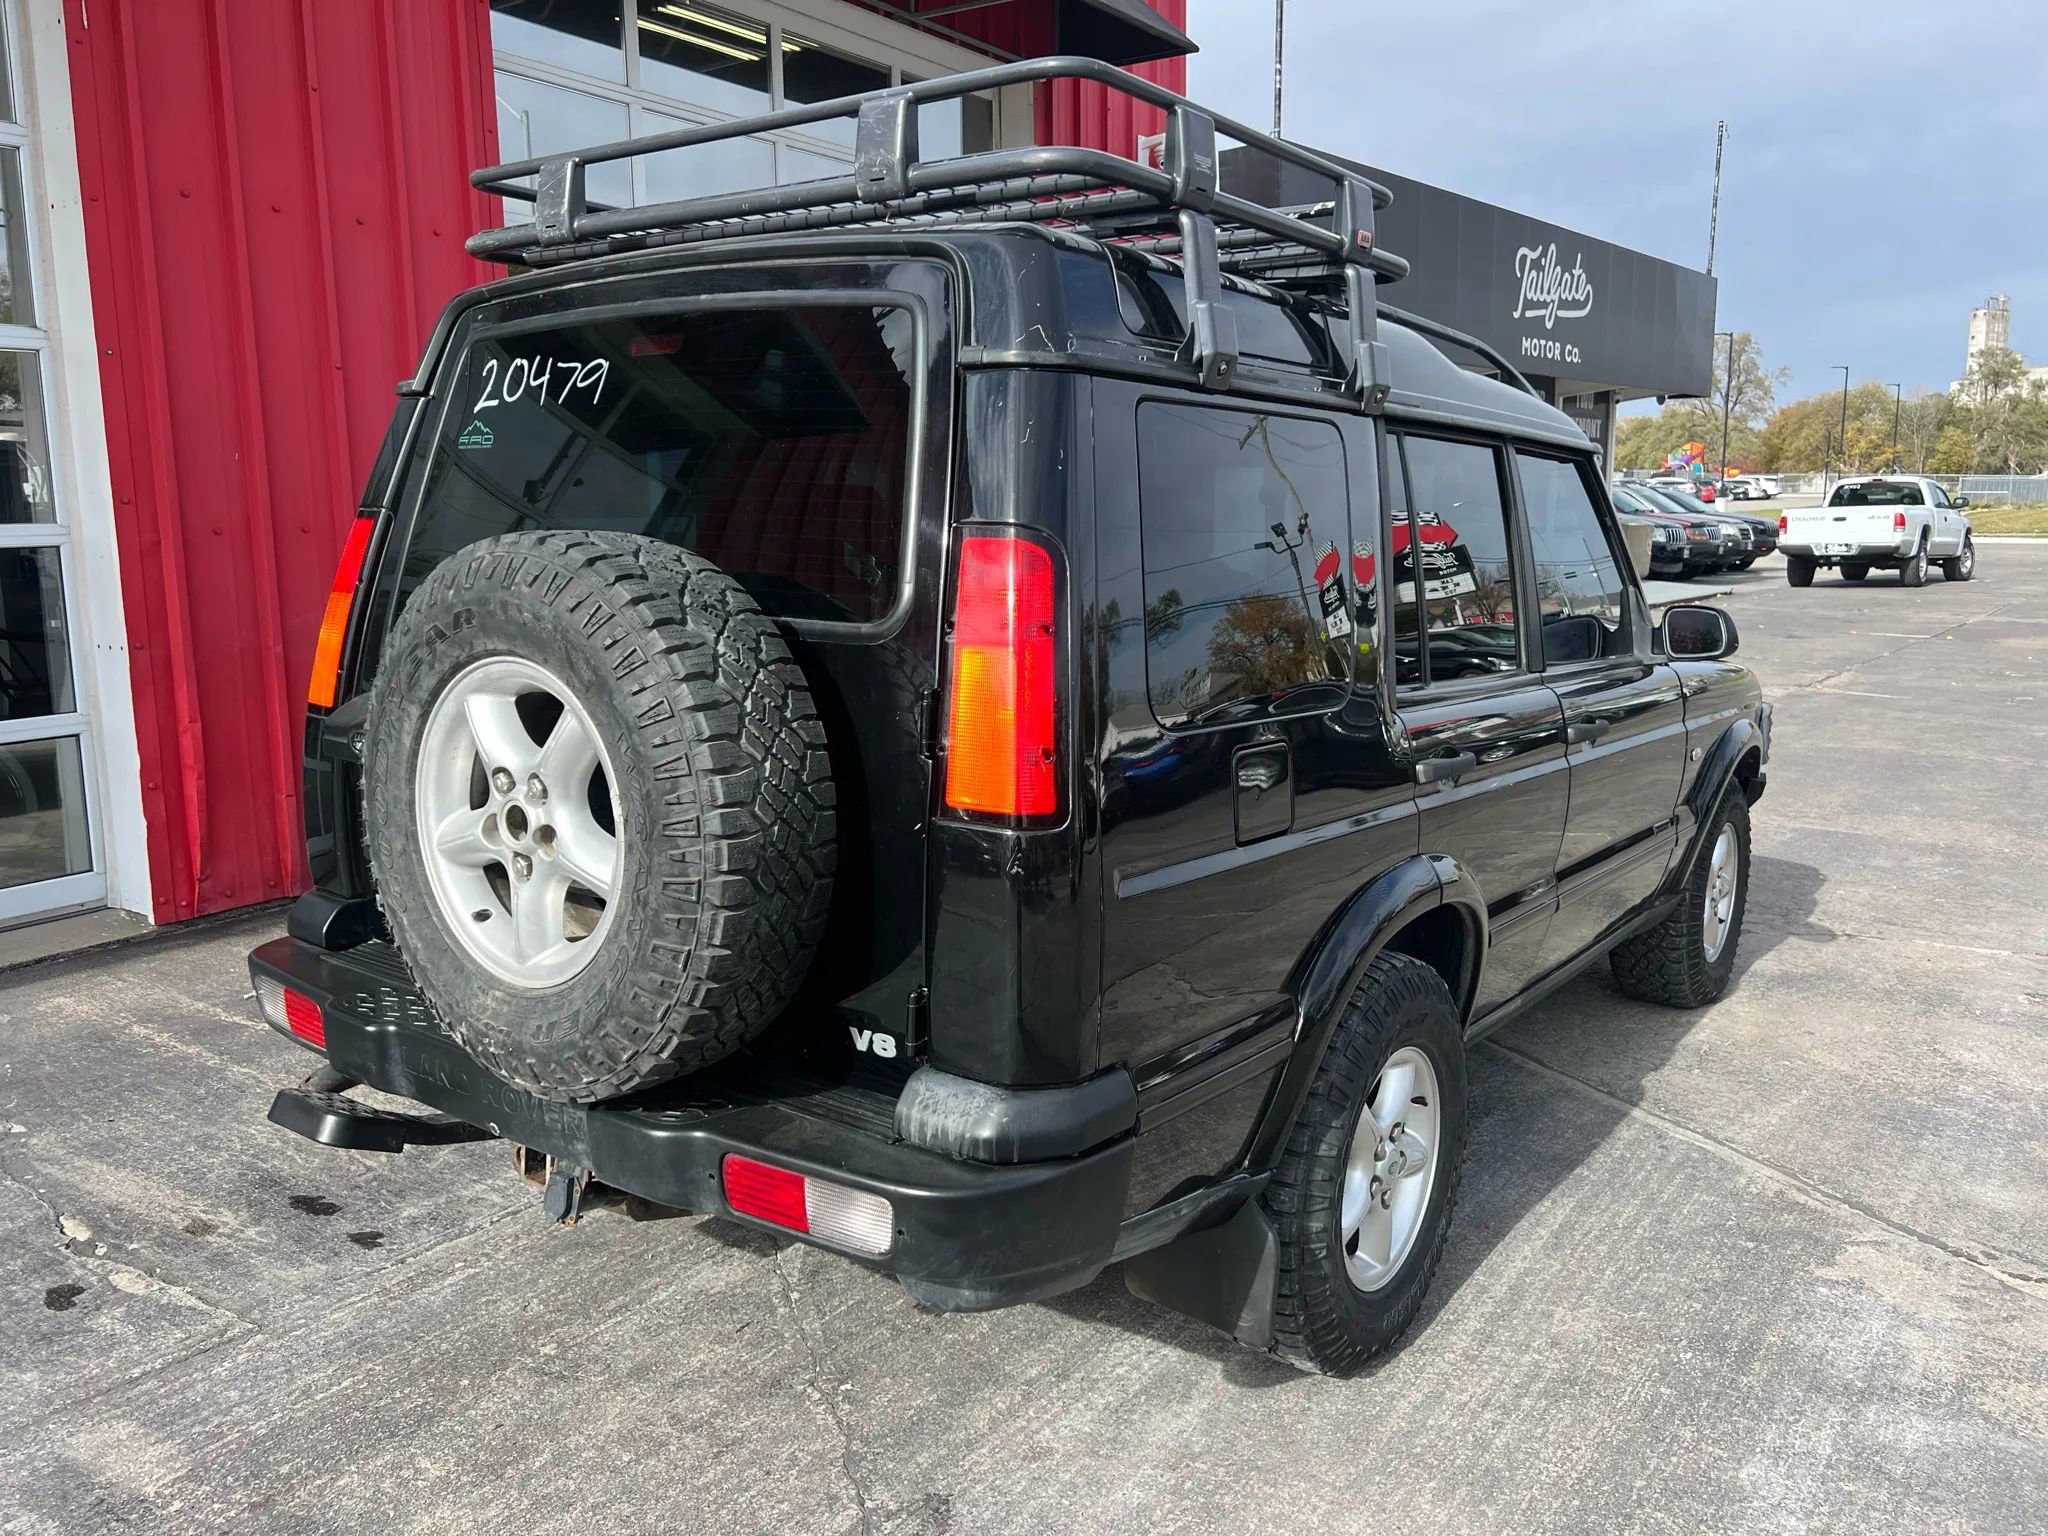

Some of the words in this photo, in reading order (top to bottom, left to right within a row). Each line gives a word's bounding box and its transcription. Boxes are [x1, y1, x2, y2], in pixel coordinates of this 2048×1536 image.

[1512, 242, 1593, 330] Tailgate
[1521, 336, 1561, 361] MOTOR
[473, 354, 610, 414] 20479
[849, 1026, 897, 1058] V8
[480, 1077, 587, 1139] ROVER
